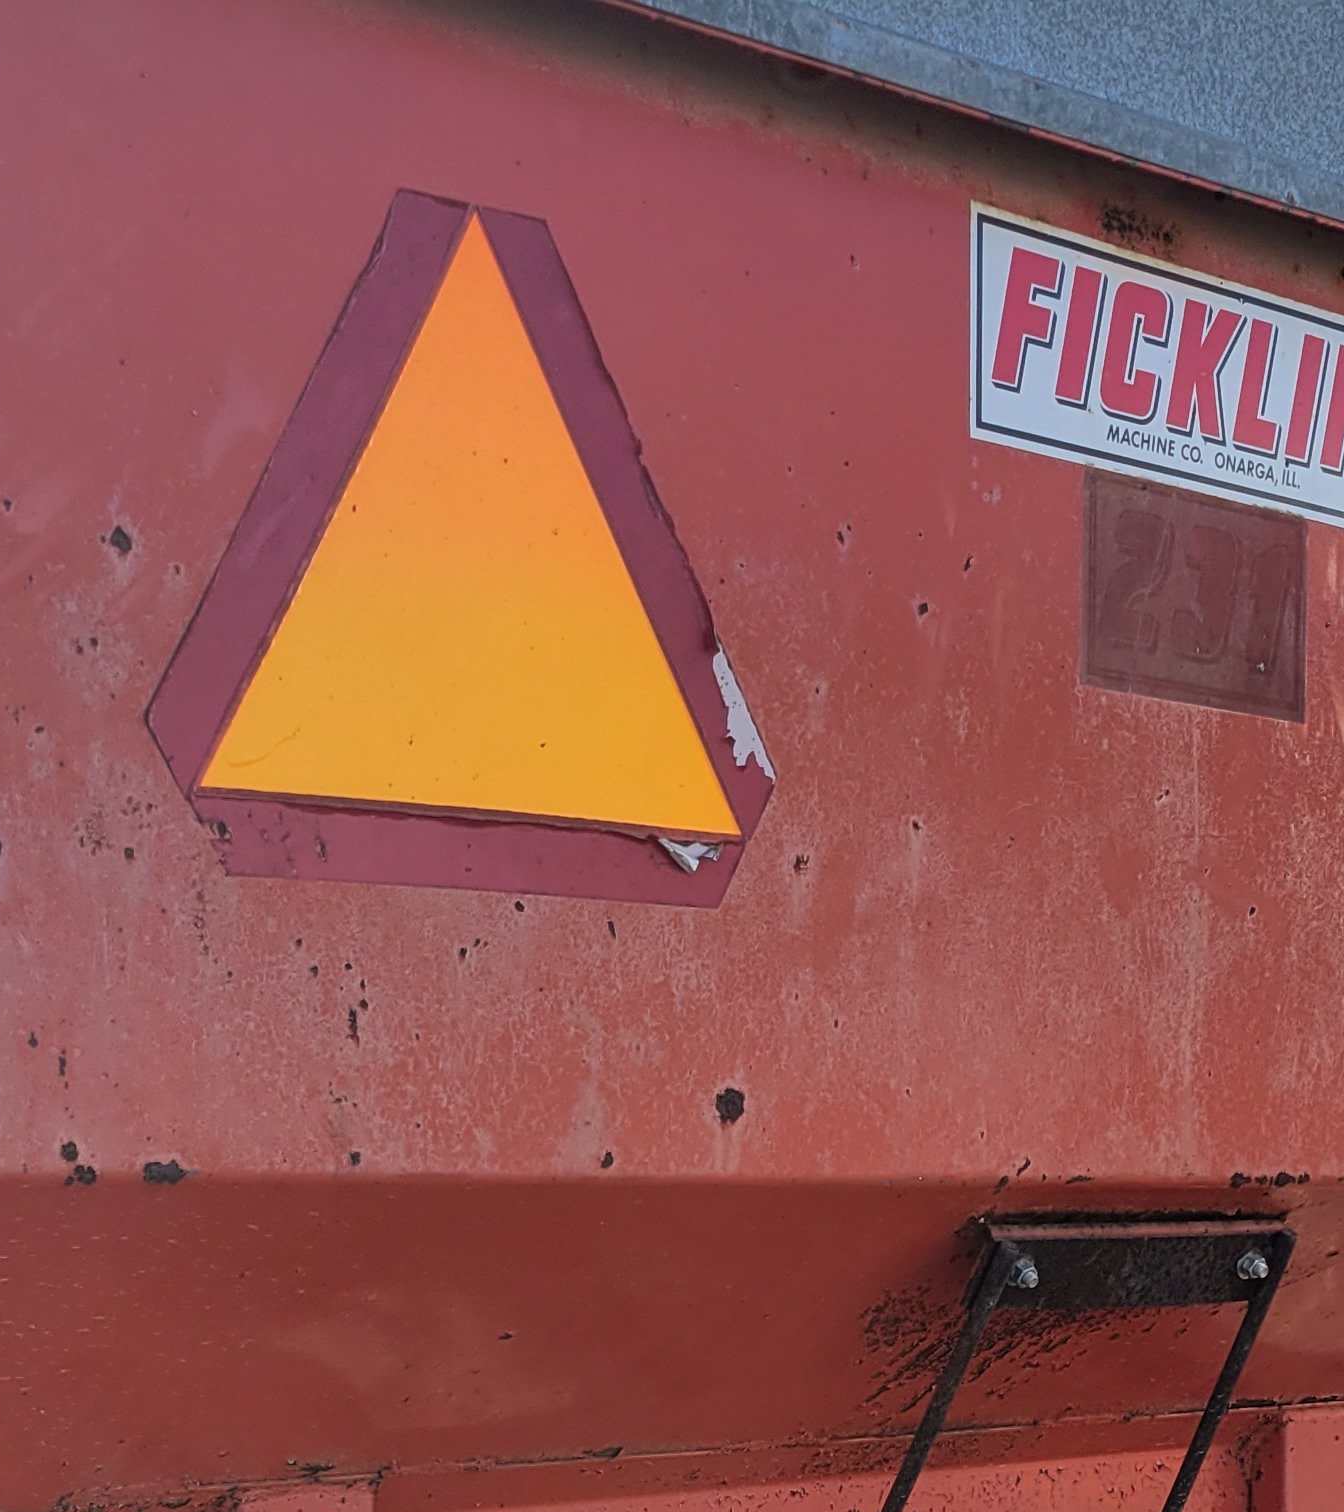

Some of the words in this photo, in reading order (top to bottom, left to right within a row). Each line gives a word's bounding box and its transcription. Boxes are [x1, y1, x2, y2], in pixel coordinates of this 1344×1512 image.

[1106, 424, 1175, 458] MACHINE
[1181, 443, 1203, 465] CO.
[1214, 452, 1279, 487] ONARGA,
[1281, 468, 1301, 490] ILL.
